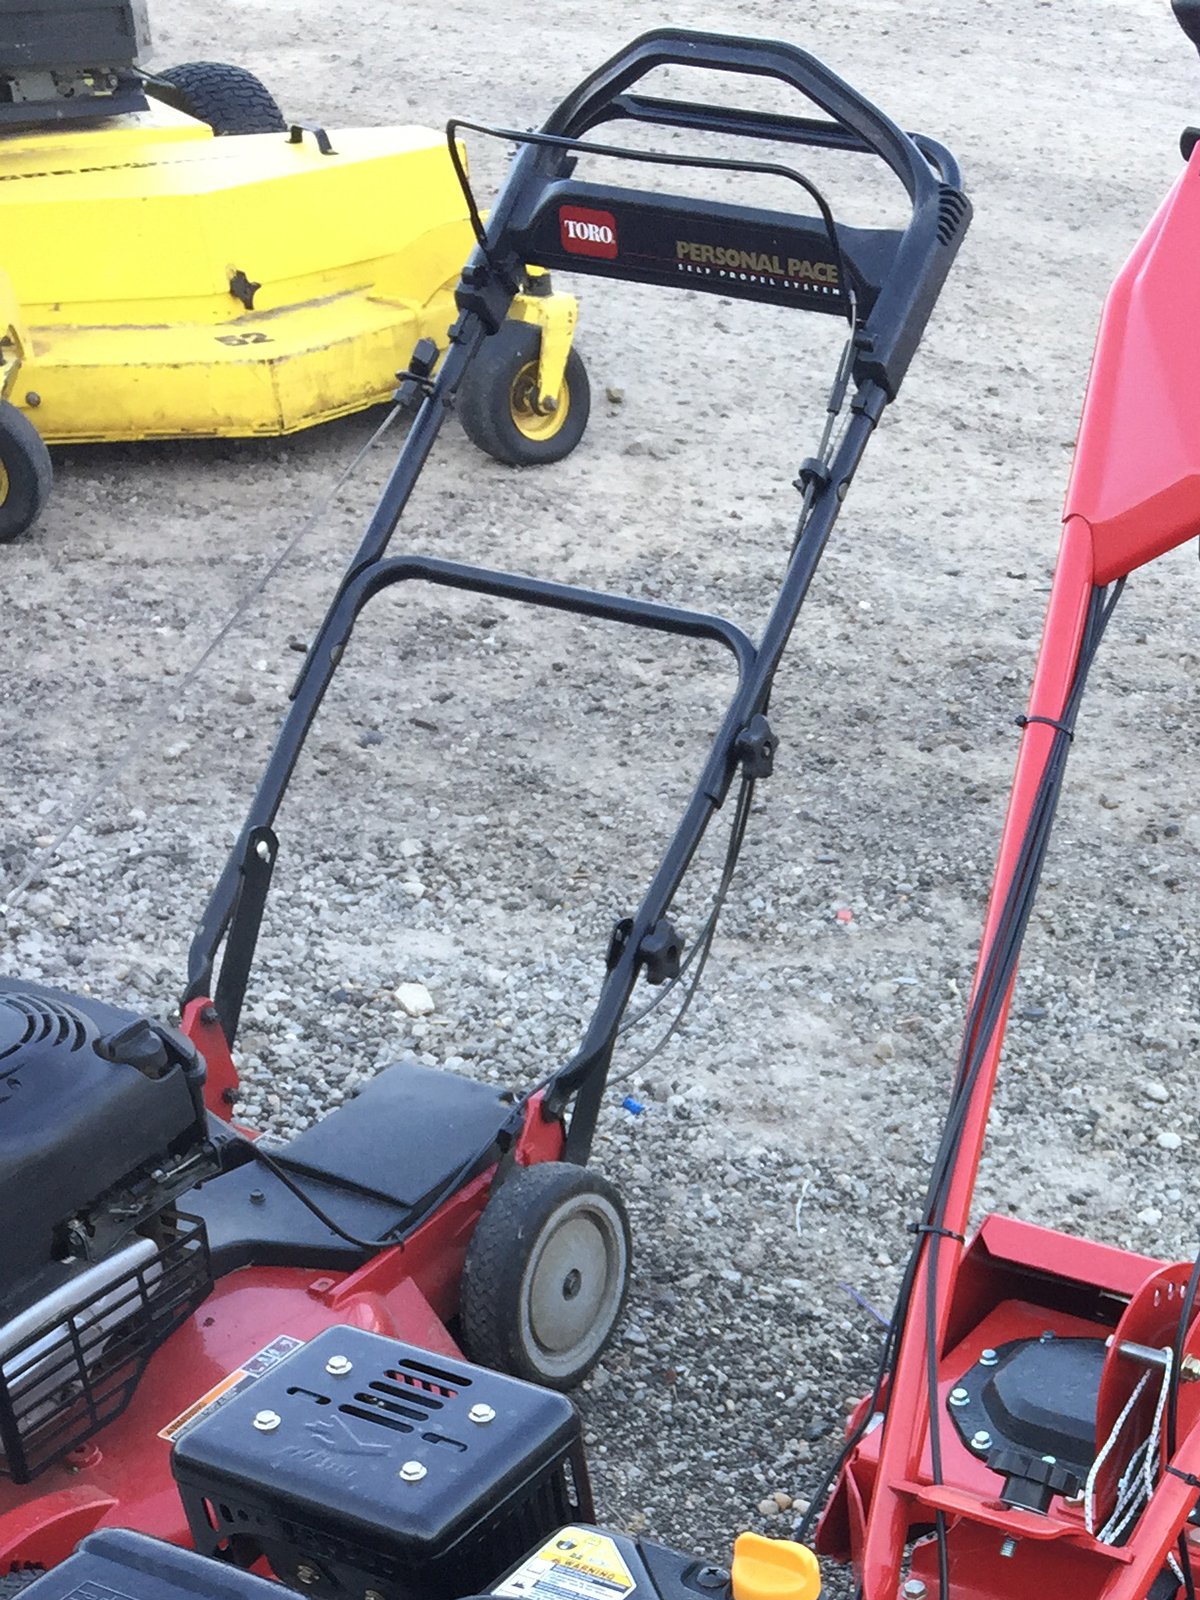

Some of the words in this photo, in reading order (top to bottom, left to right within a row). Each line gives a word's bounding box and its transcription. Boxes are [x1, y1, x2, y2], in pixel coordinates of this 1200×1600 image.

[564, 219, 613, 244] TORO
[676, 240, 785, 275] PERSONAL
[787, 258, 839, 284] PACE
[720, 270, 776, 286] PROPEL
[784, 280, 840, 296] SYSTEM
